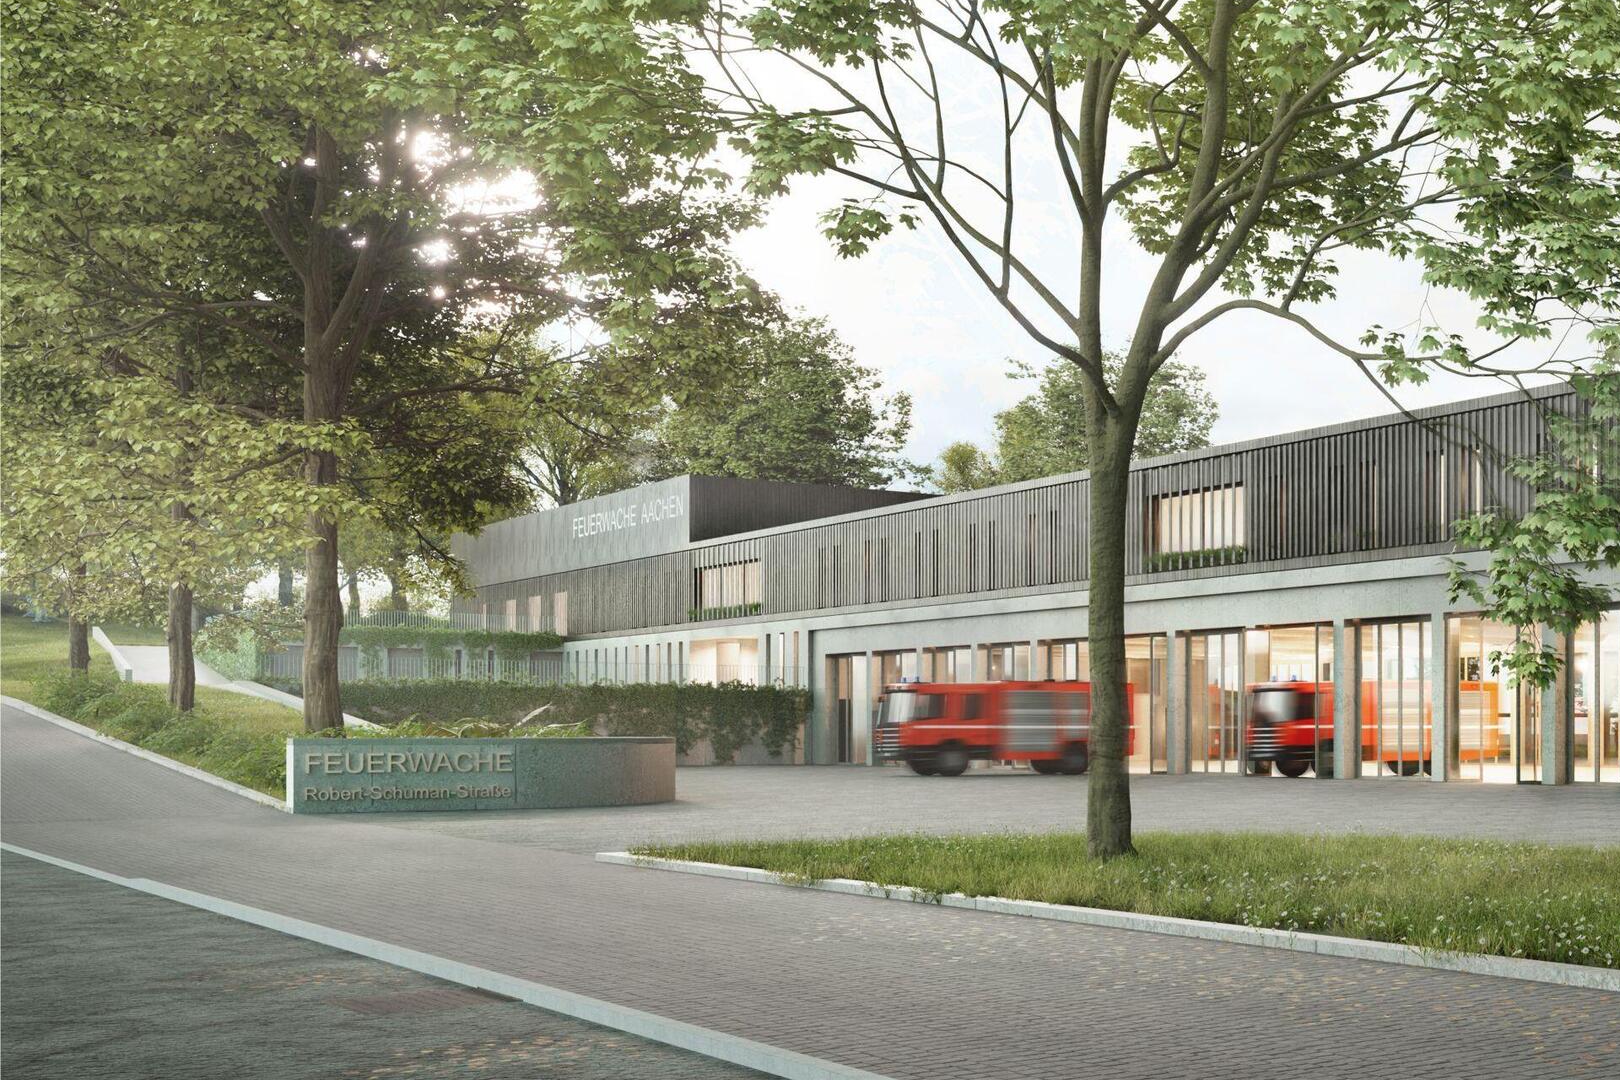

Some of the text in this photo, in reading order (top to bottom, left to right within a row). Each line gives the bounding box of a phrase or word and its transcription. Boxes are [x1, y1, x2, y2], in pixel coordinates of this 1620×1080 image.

[572, 495, 684, 539] FEUERWACHE AACHEN
[304, 751, 513, 774] FEUERWACHE
[304, 785, 512, 802] Robert-Schuman-Straße
